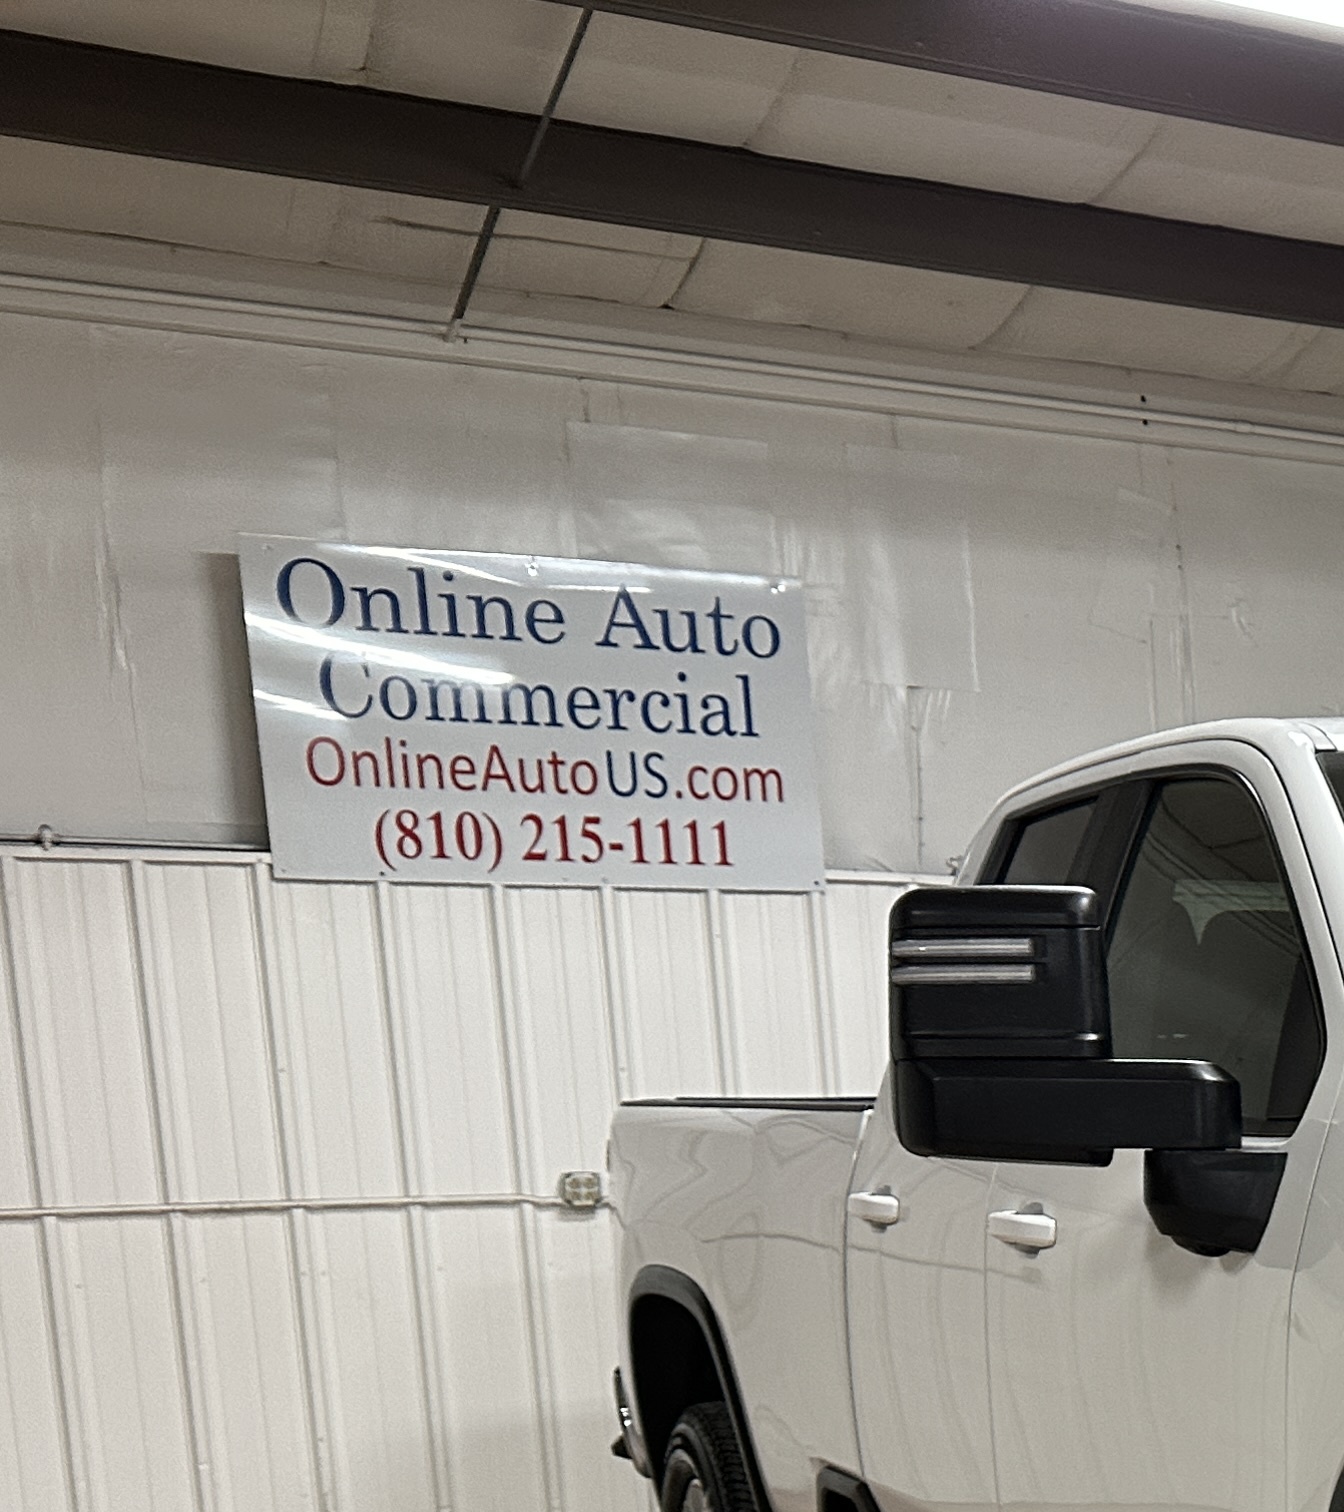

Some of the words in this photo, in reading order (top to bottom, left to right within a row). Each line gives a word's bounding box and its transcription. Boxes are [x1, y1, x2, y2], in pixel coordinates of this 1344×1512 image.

[276, 557, 566, 646] Online
[595, 584, 781, 660] Auto
[318, 649, 761, 738] Commercial
[305, 735, 786, 803] OnlineAutoUS.com
[374, 809, 502, 873] (810)
[521, 813, 735, 867] 215-1111
